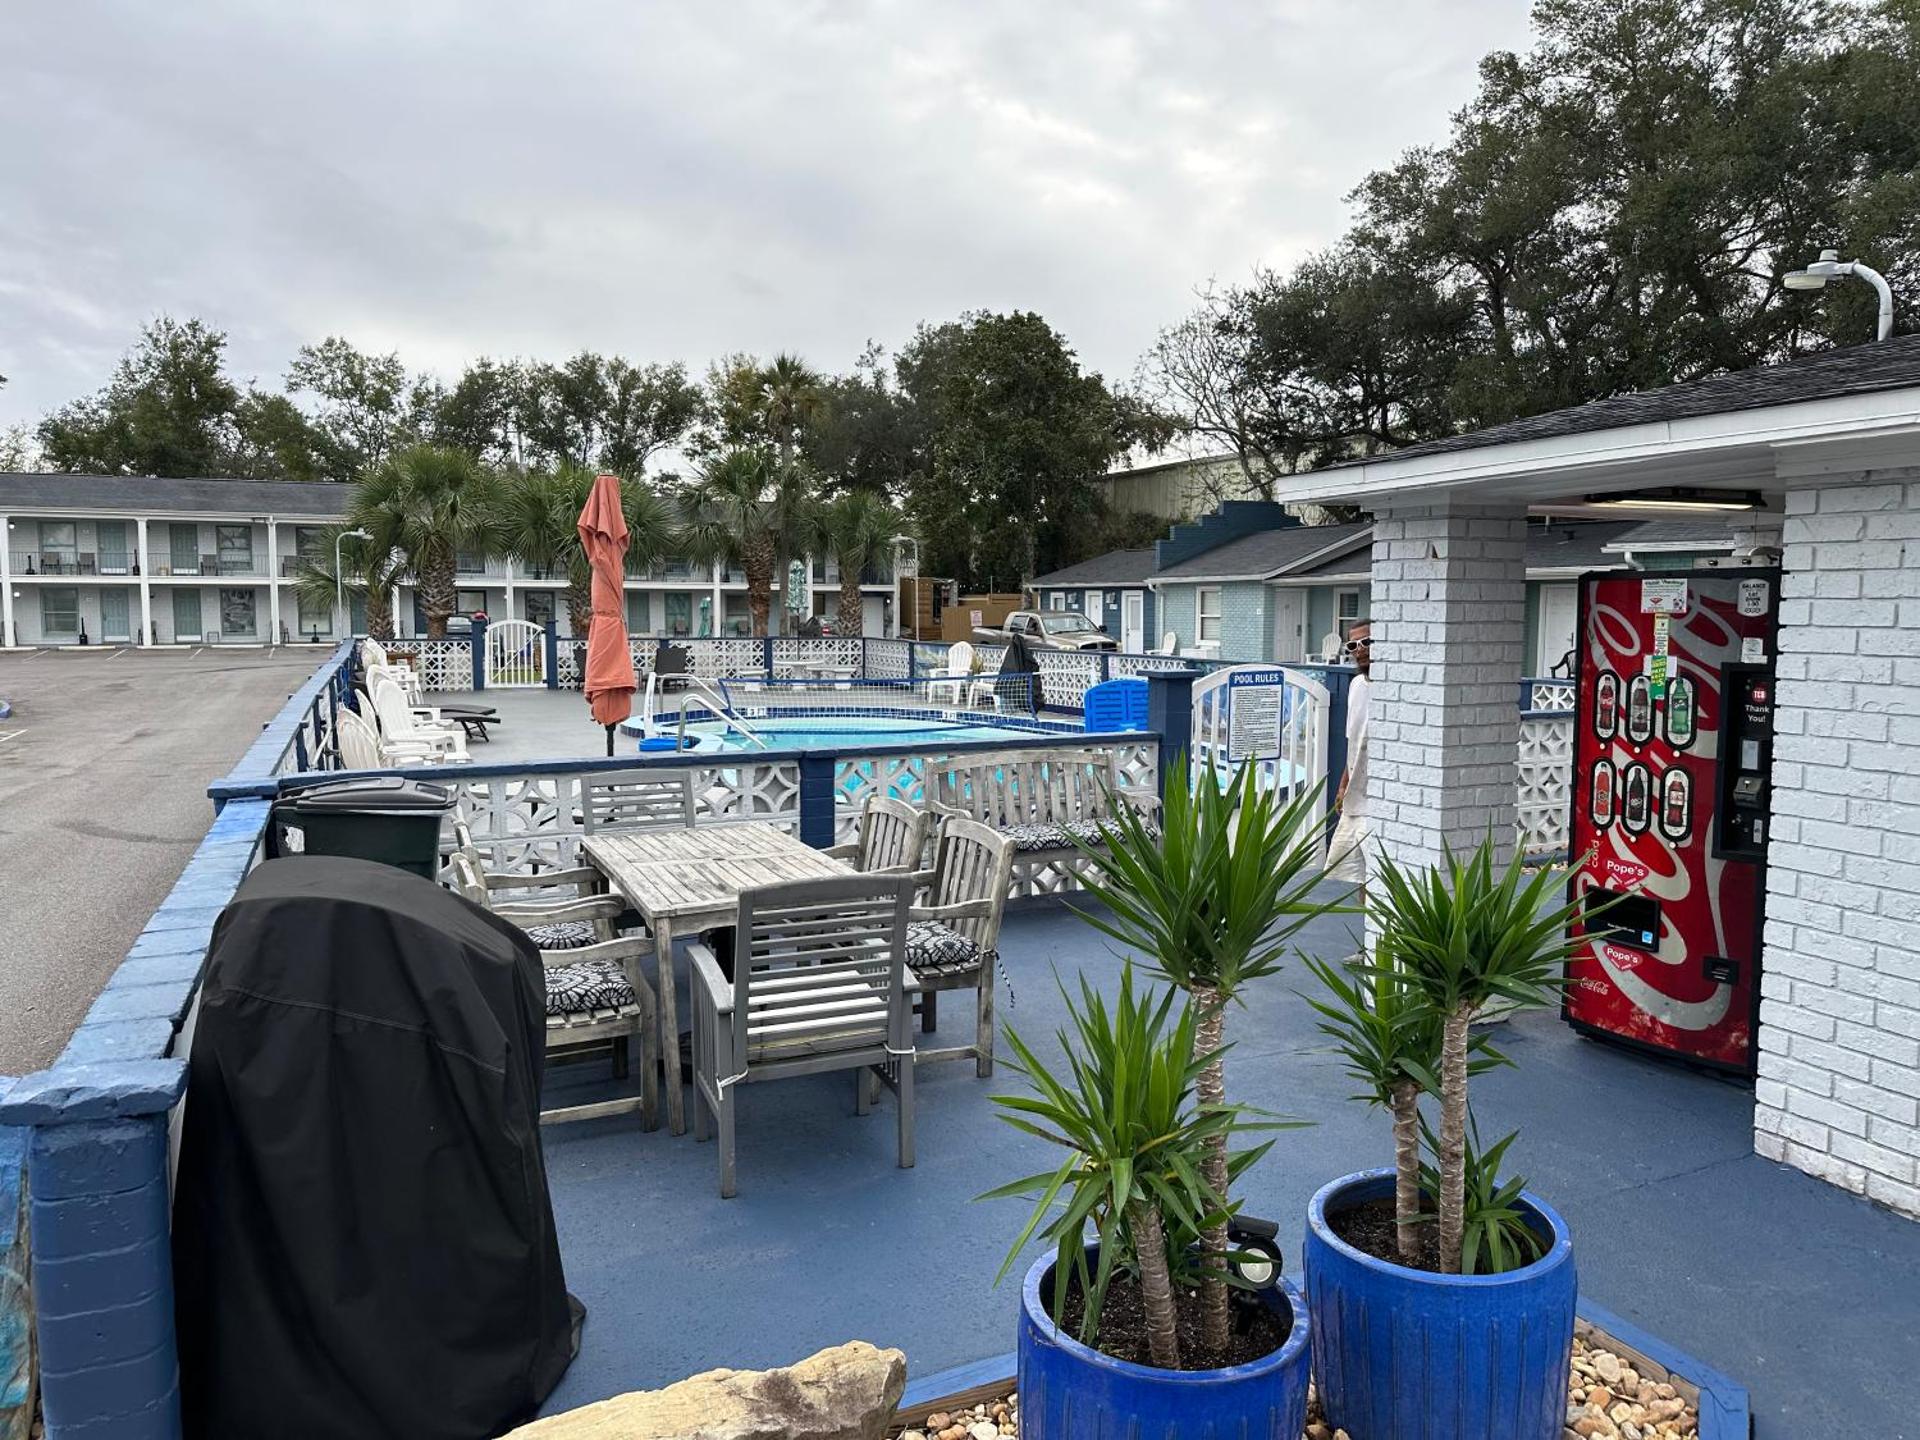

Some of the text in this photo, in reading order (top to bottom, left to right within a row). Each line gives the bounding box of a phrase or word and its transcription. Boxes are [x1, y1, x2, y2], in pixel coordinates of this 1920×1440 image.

[1234, 673, 1279, 685] POOL RULES
[1745, 704, 1770, 713] Thank
[1748, 714, 1766, 723] You!
[1607, 860, 1645, 877] Pope's
[1607, 947, 1638, 963] Pope's
